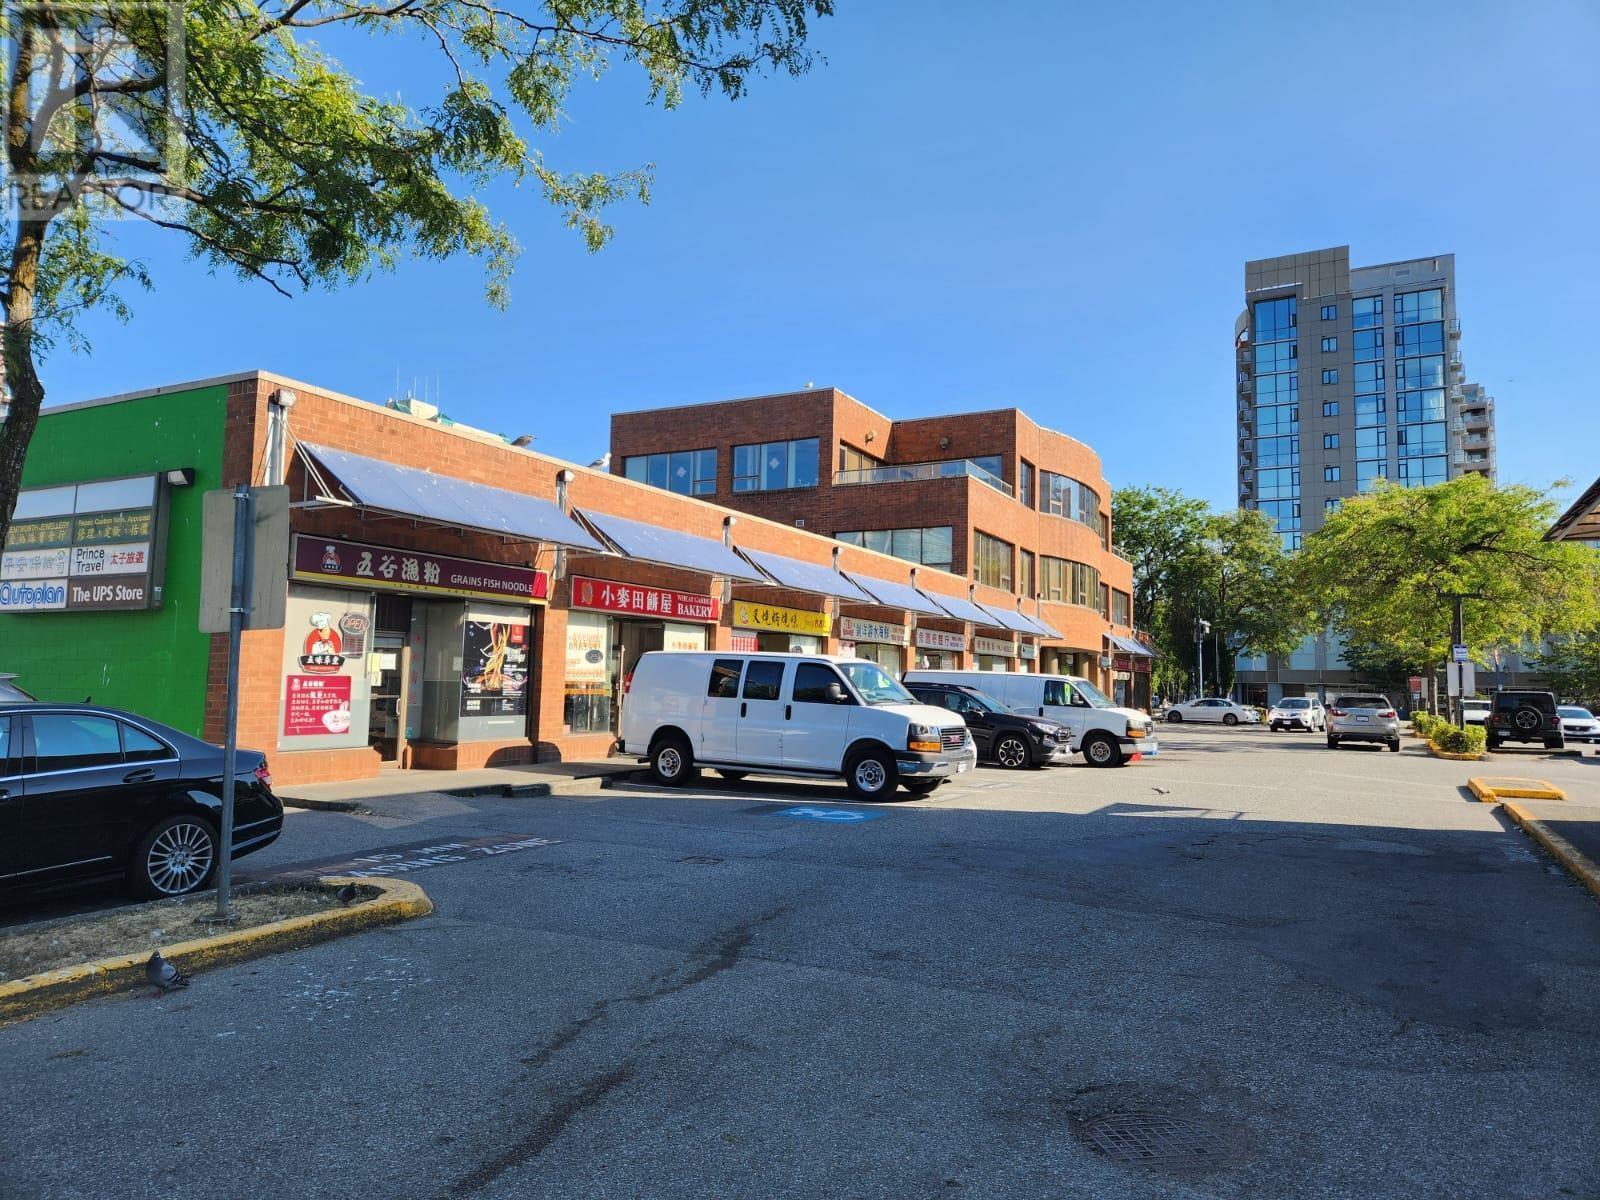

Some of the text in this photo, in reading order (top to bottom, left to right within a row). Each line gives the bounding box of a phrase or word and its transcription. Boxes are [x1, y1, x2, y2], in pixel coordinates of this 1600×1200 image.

[77, 548, 105, 560] Prince
[76, 559, 105, 573] Travel
[450, 574, 533, 593] GRAINS FISH NOODLE
[73, 585, 143, 602] The UPS Store
[677, 603, 713, 618] BAKERY
